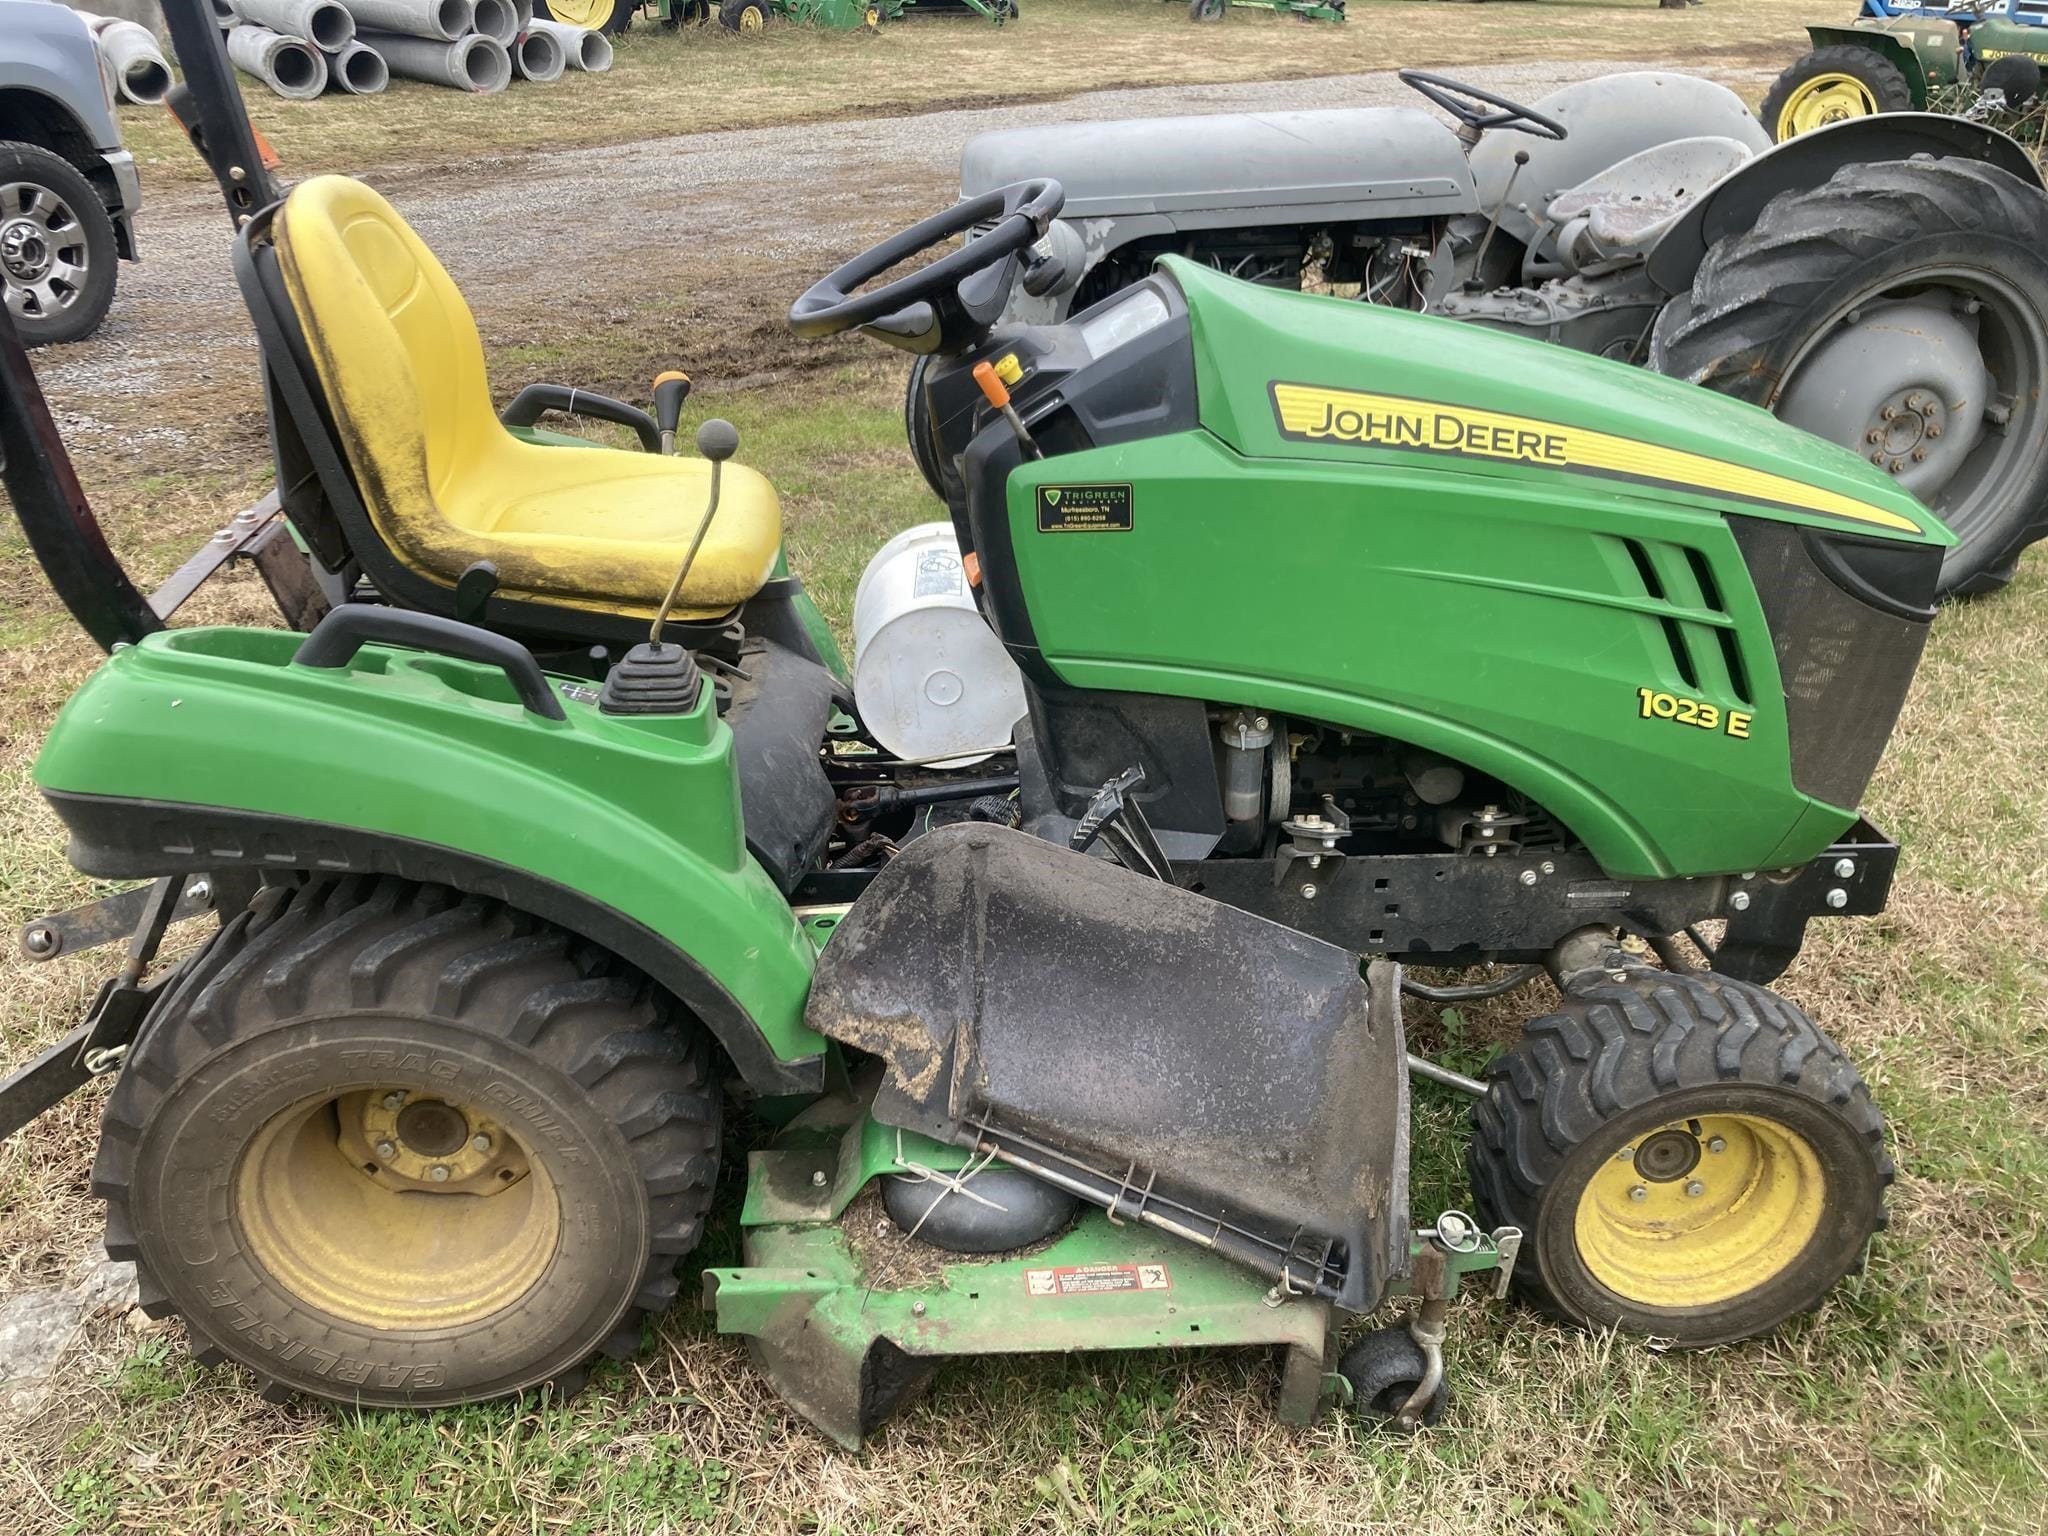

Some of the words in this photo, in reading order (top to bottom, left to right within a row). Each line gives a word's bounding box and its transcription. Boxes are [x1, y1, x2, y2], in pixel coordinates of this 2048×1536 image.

[1310, 403, 1422, 442] JOHN
[1434, 414, 1568, 462] DEERE
[1638, 687, 1720, 729] 1023
[1724, 711, 1752, 739] E
[339, 1049, 462, 1081] TRAC
[483, 1081, 588, 1166] CHIEF
[1081, 1265, 1118, 1273] DANGER
[196, 1280, 448, 1389] CARLISLE
